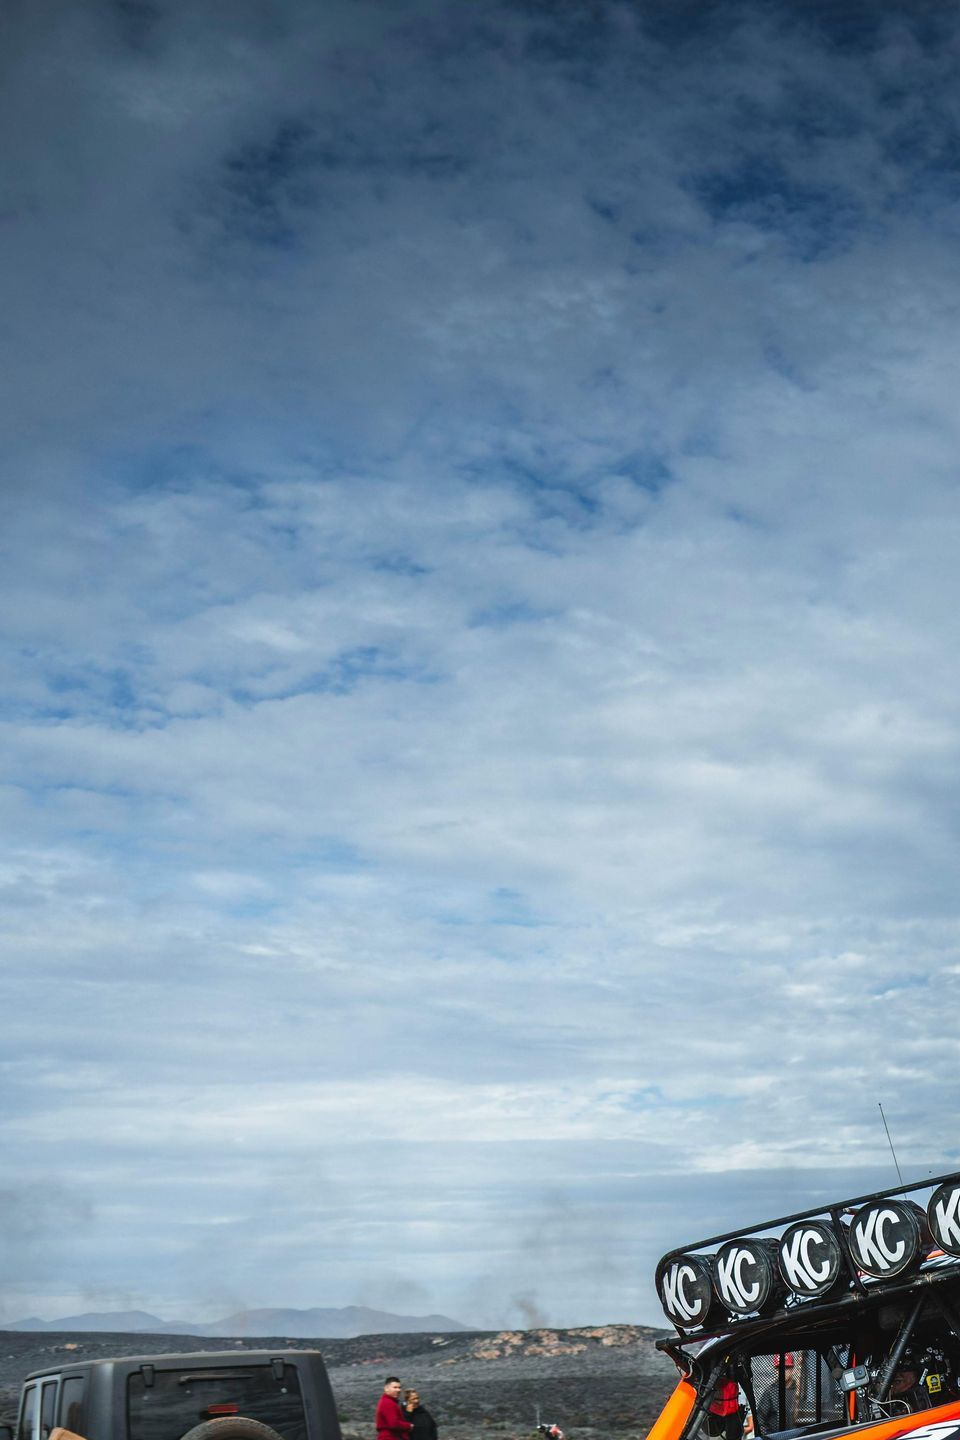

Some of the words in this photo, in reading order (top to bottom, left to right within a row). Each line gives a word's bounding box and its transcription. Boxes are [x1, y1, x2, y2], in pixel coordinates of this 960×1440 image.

[781, 1230, 831, 1290] KC
[855, 1208, 906, 1270] KC
[662, 1262, 702, 1321] KC
[717, 1248, 760, 1308] KC
